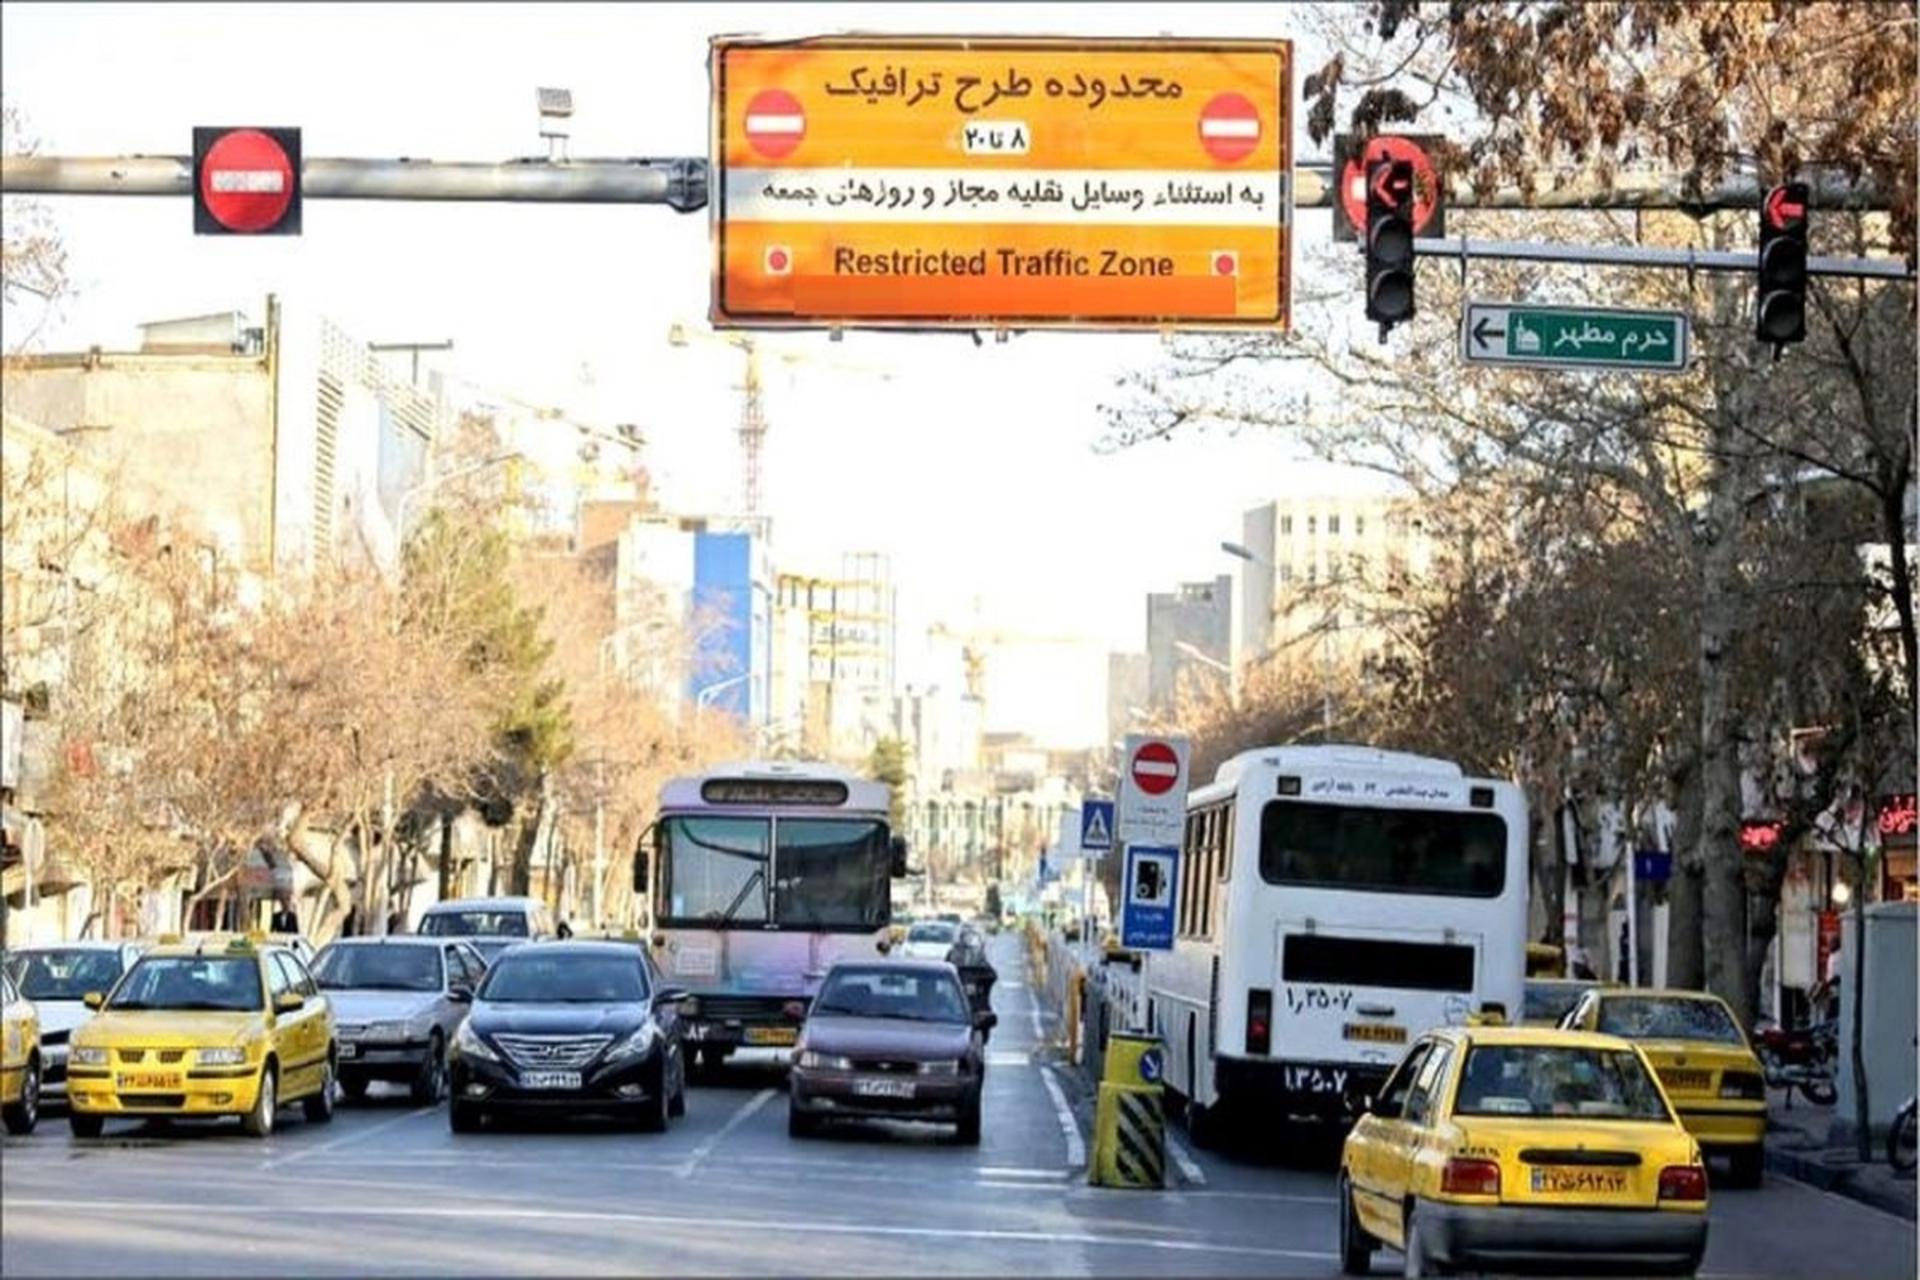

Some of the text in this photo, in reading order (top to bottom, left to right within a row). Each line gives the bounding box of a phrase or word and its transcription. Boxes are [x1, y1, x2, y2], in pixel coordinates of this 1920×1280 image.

[825, 66, 1184, 113] محدوده طرح ترافیک
[965, 128, 1026, 149] ۸ تا ۲۰
[762, 179, 1265, 212] به استثناء وسایل نقلیه مجاز و روزهای جمعه
[834, 246, 1174, 277] Restricted Traffic Zone
[1553, 320, 1669, 357] حرم مطهر
